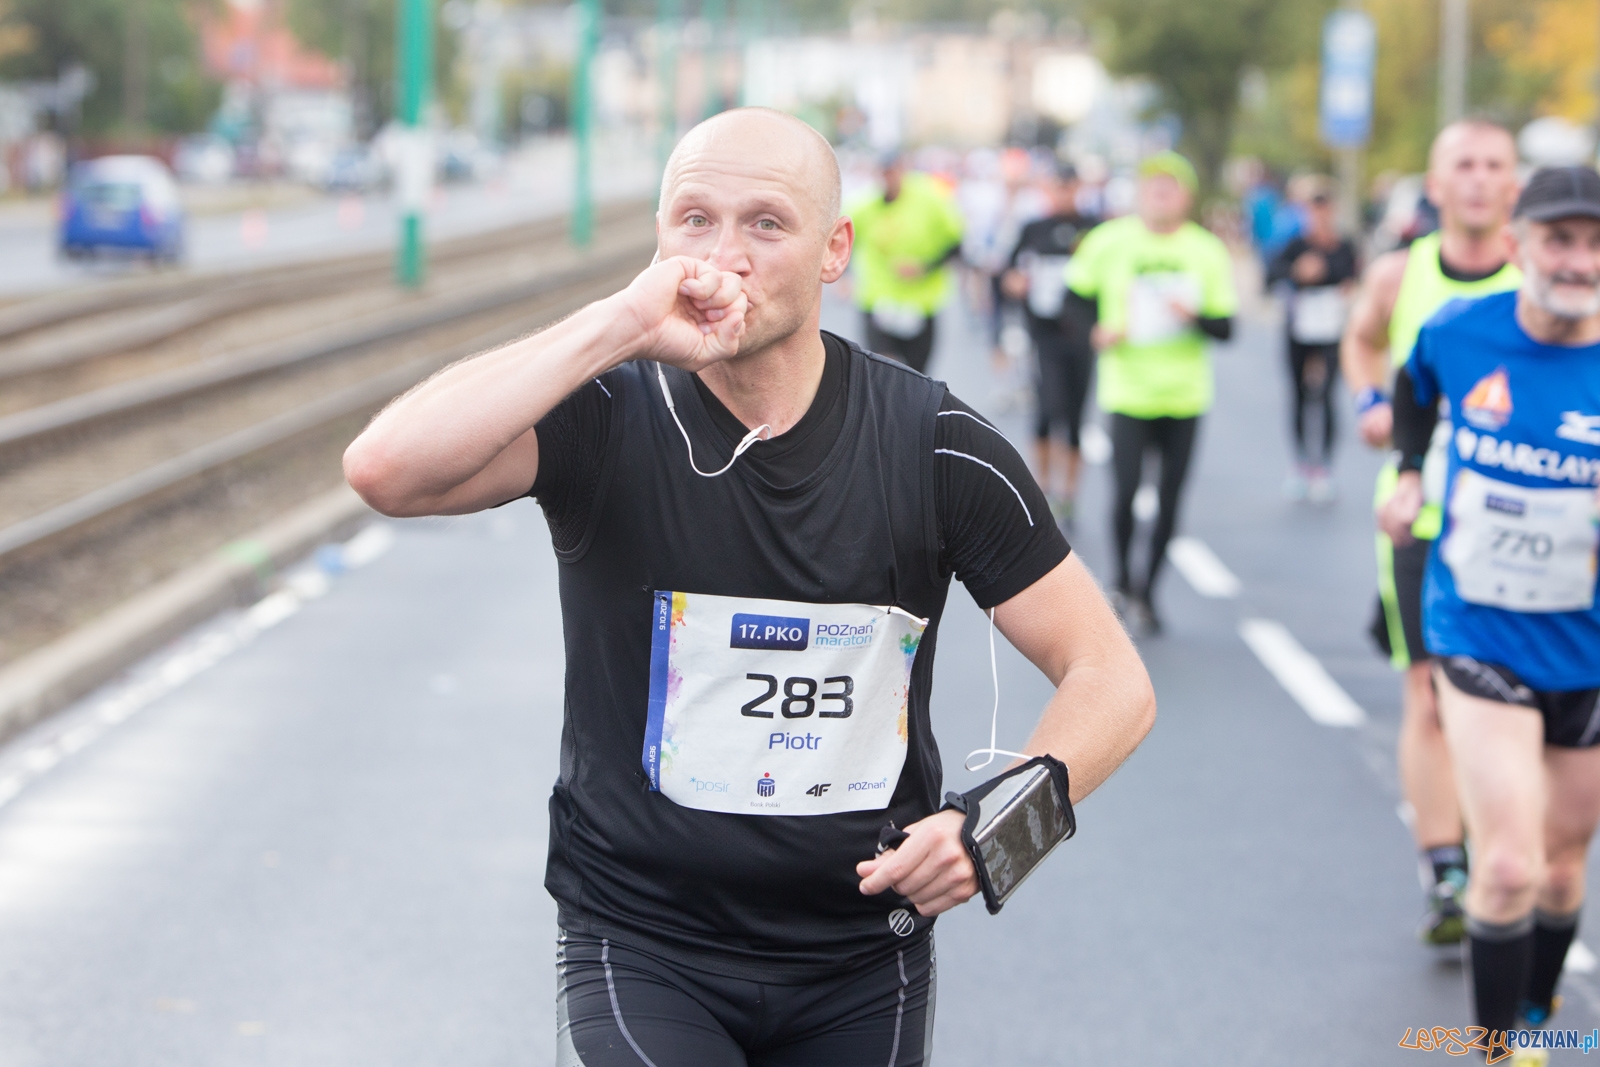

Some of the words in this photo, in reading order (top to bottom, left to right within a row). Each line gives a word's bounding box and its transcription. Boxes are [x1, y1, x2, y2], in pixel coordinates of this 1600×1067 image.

[1490, 526, 1554, 561] 770
[739, 623, 762, 640] 17.
[764, 625, 803, 642] PKO
[815, 634, 873, 647] maraton
[740, 673, 854, 719] 283
[768, 732, 823, 751] Piotr
[648, 745, 657, 763] M36
[805, 783, 832, 797] 4F
